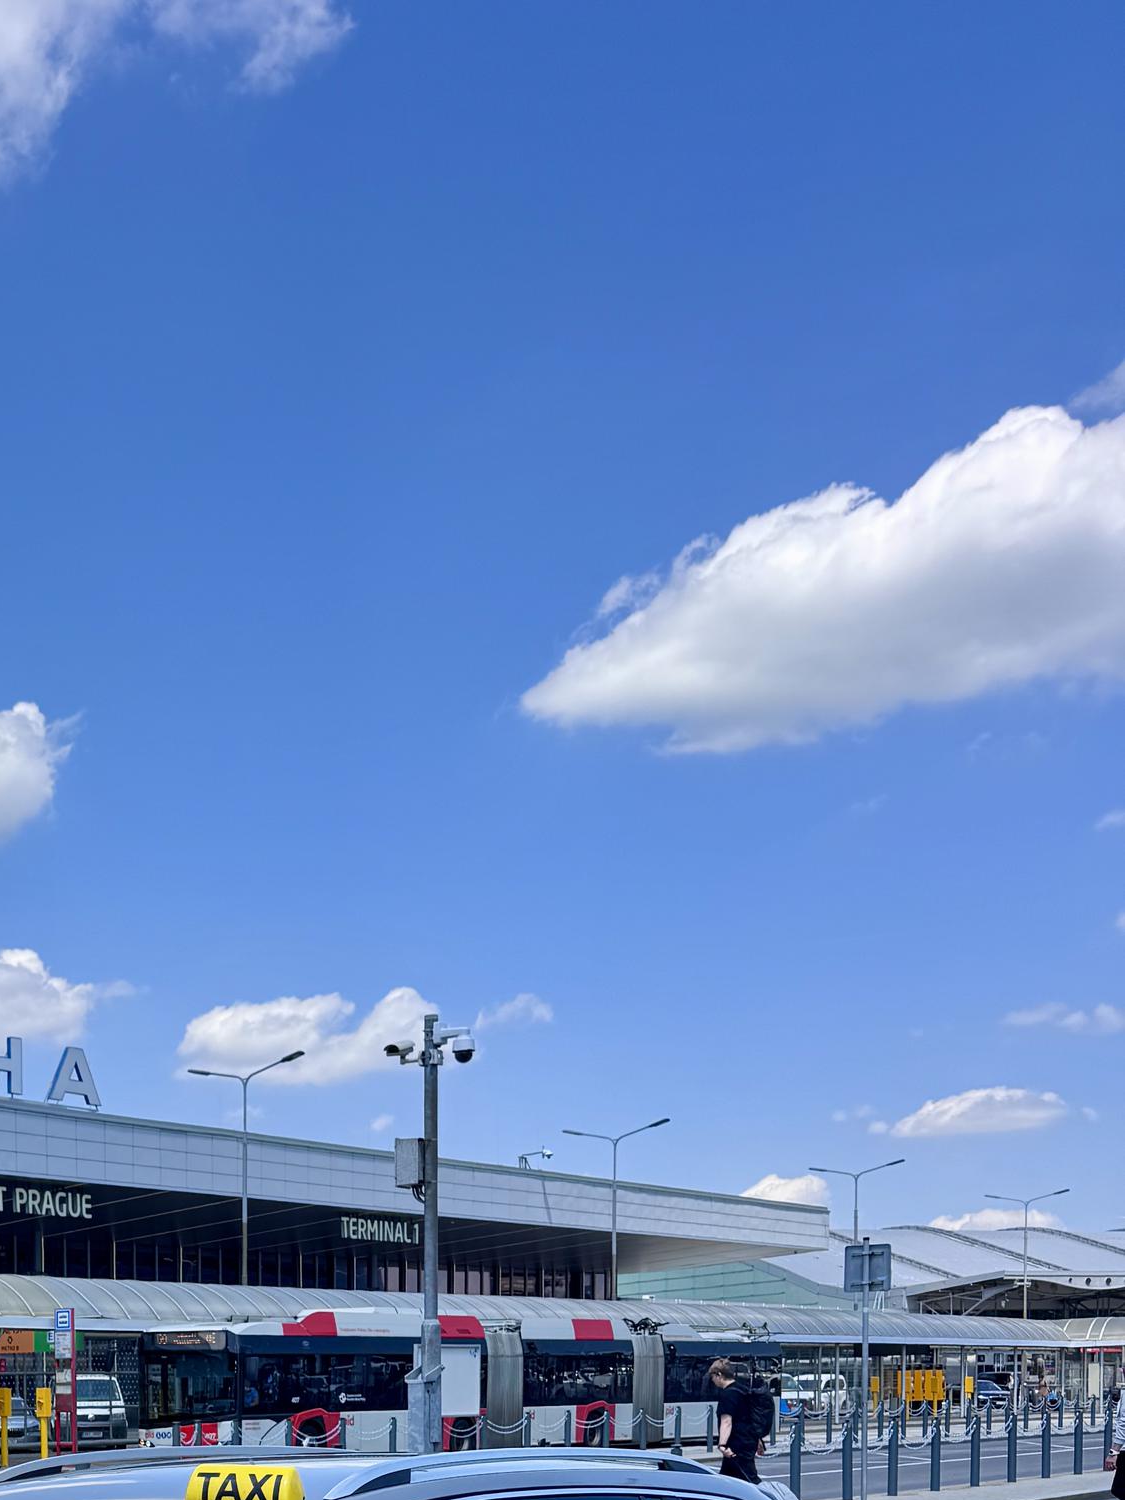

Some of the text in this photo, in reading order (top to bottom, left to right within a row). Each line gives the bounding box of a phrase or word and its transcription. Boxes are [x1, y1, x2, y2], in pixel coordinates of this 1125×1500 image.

[12, 1186, 93, 1220] PRAGUE
[341, 1215, 420, 1245] TERMINAL 1
